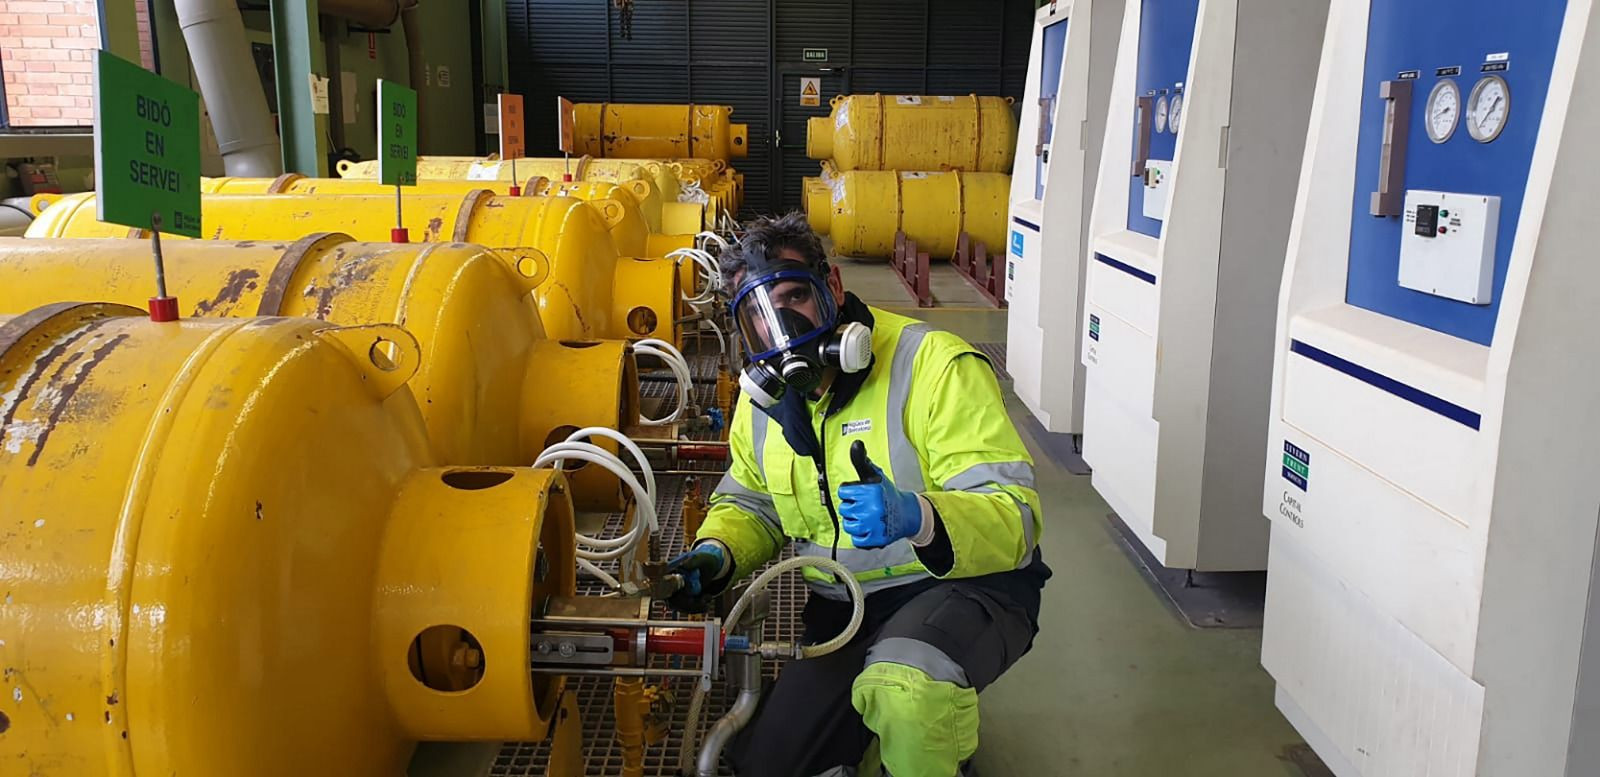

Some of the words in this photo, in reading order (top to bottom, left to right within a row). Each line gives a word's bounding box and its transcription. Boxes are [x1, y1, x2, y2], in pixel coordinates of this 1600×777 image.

[136, 94, 171, 127] BIDÓ
[395, 124, 403, 137] EN
[145, 131, 164, 157] EN
[390, 143, 408, 160] SERVEI
[129, 159, 180, 193] SERVEI
[1285, 443, 1308, 462] SEVERN
[1286, 457, 1306, 474] TRENT
